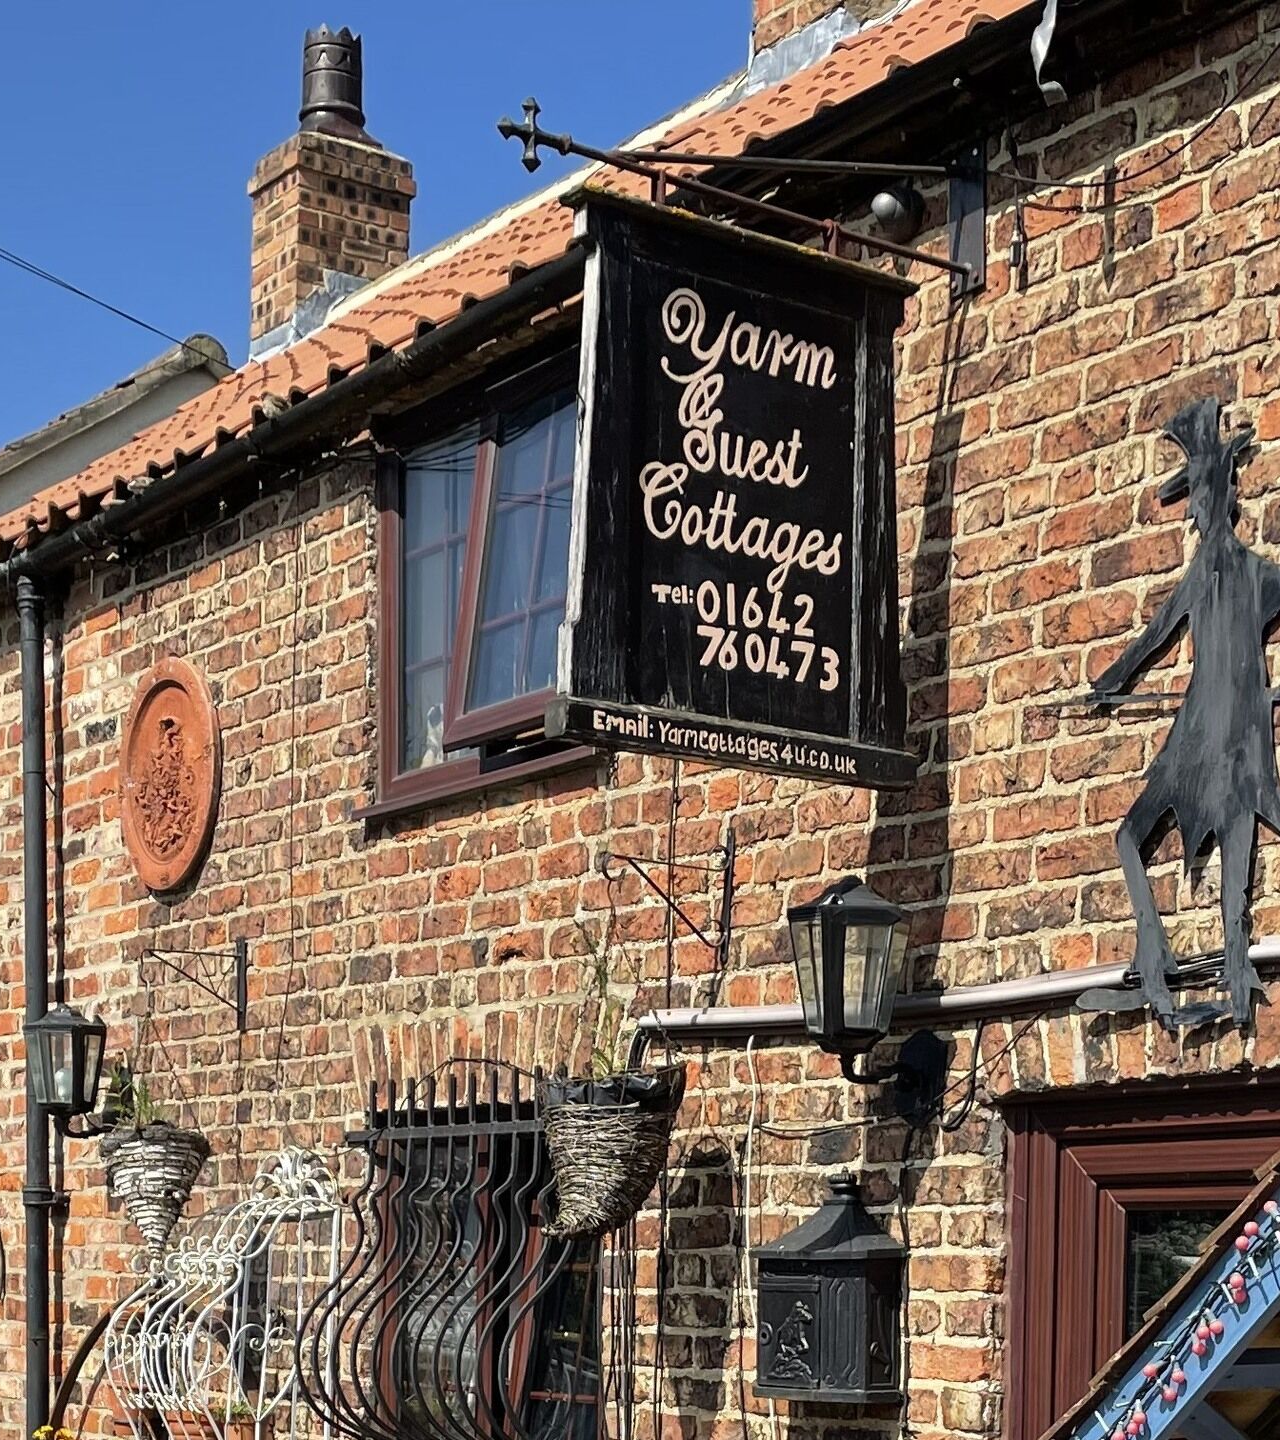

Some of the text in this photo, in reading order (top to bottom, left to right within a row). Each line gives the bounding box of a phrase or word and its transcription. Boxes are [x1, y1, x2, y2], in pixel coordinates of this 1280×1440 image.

[661, 287, 837, 389] Yarm
[678, 373, 809, 488] Guest
[639, 461, 843, 593] Cottages
[651, 580, 815, 637] Tel: 01642
[696, 624, 840, 691] 760473
